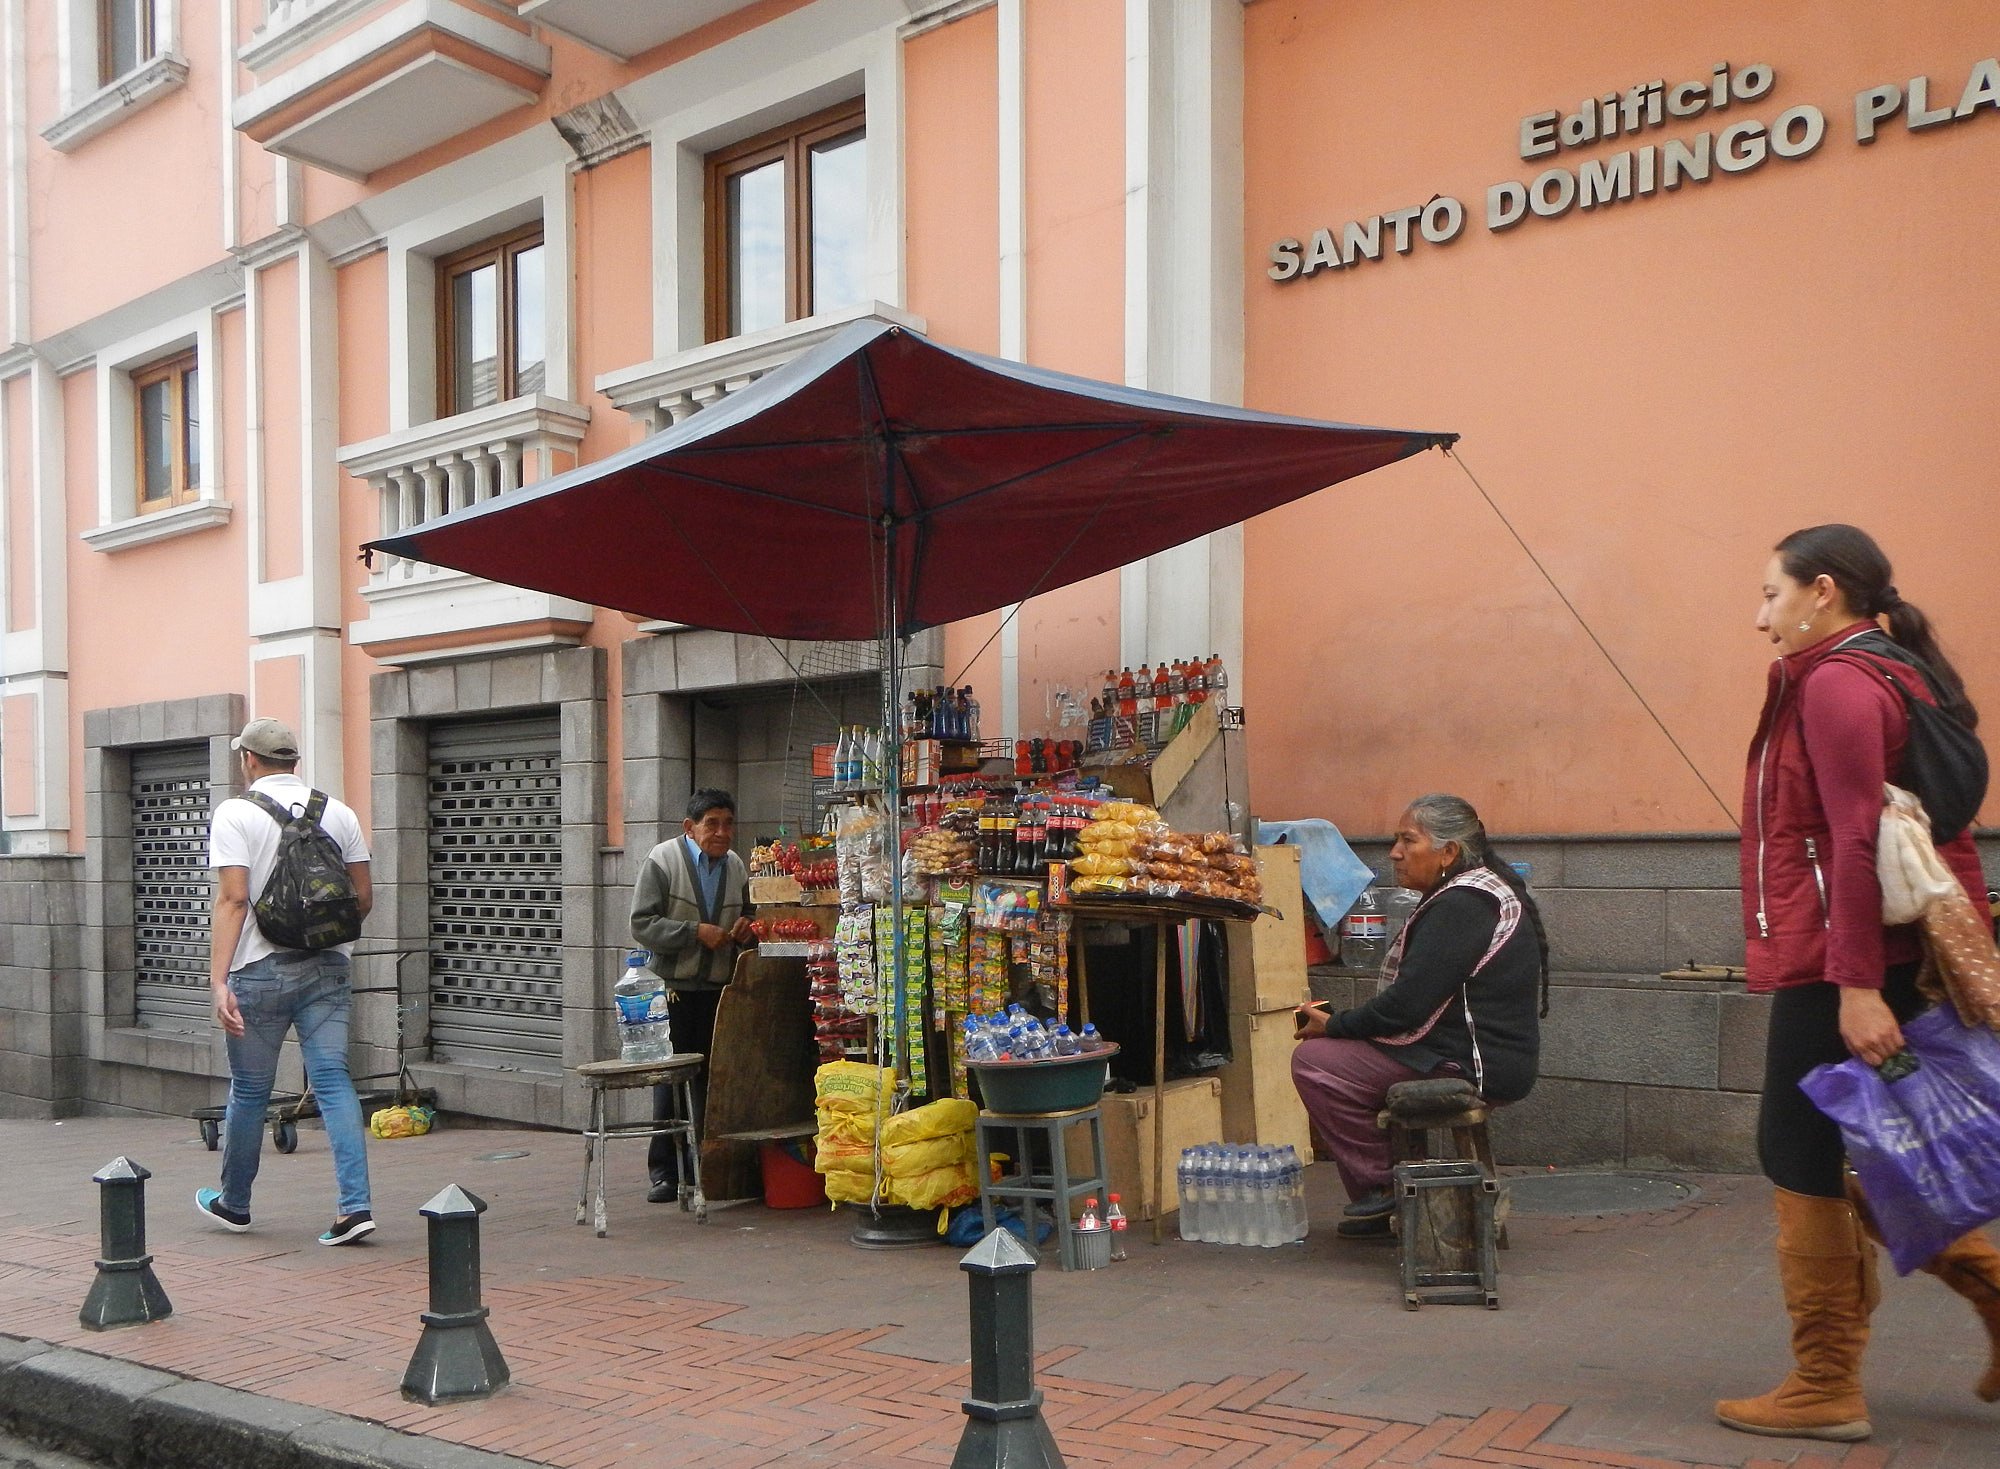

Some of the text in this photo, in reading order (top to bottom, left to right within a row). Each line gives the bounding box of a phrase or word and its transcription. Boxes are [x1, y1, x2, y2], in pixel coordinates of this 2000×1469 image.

[1267, 57, 2000, 282] SANTO DOMINGO PLA
[1519, 61, 1776, 161] Edificio
